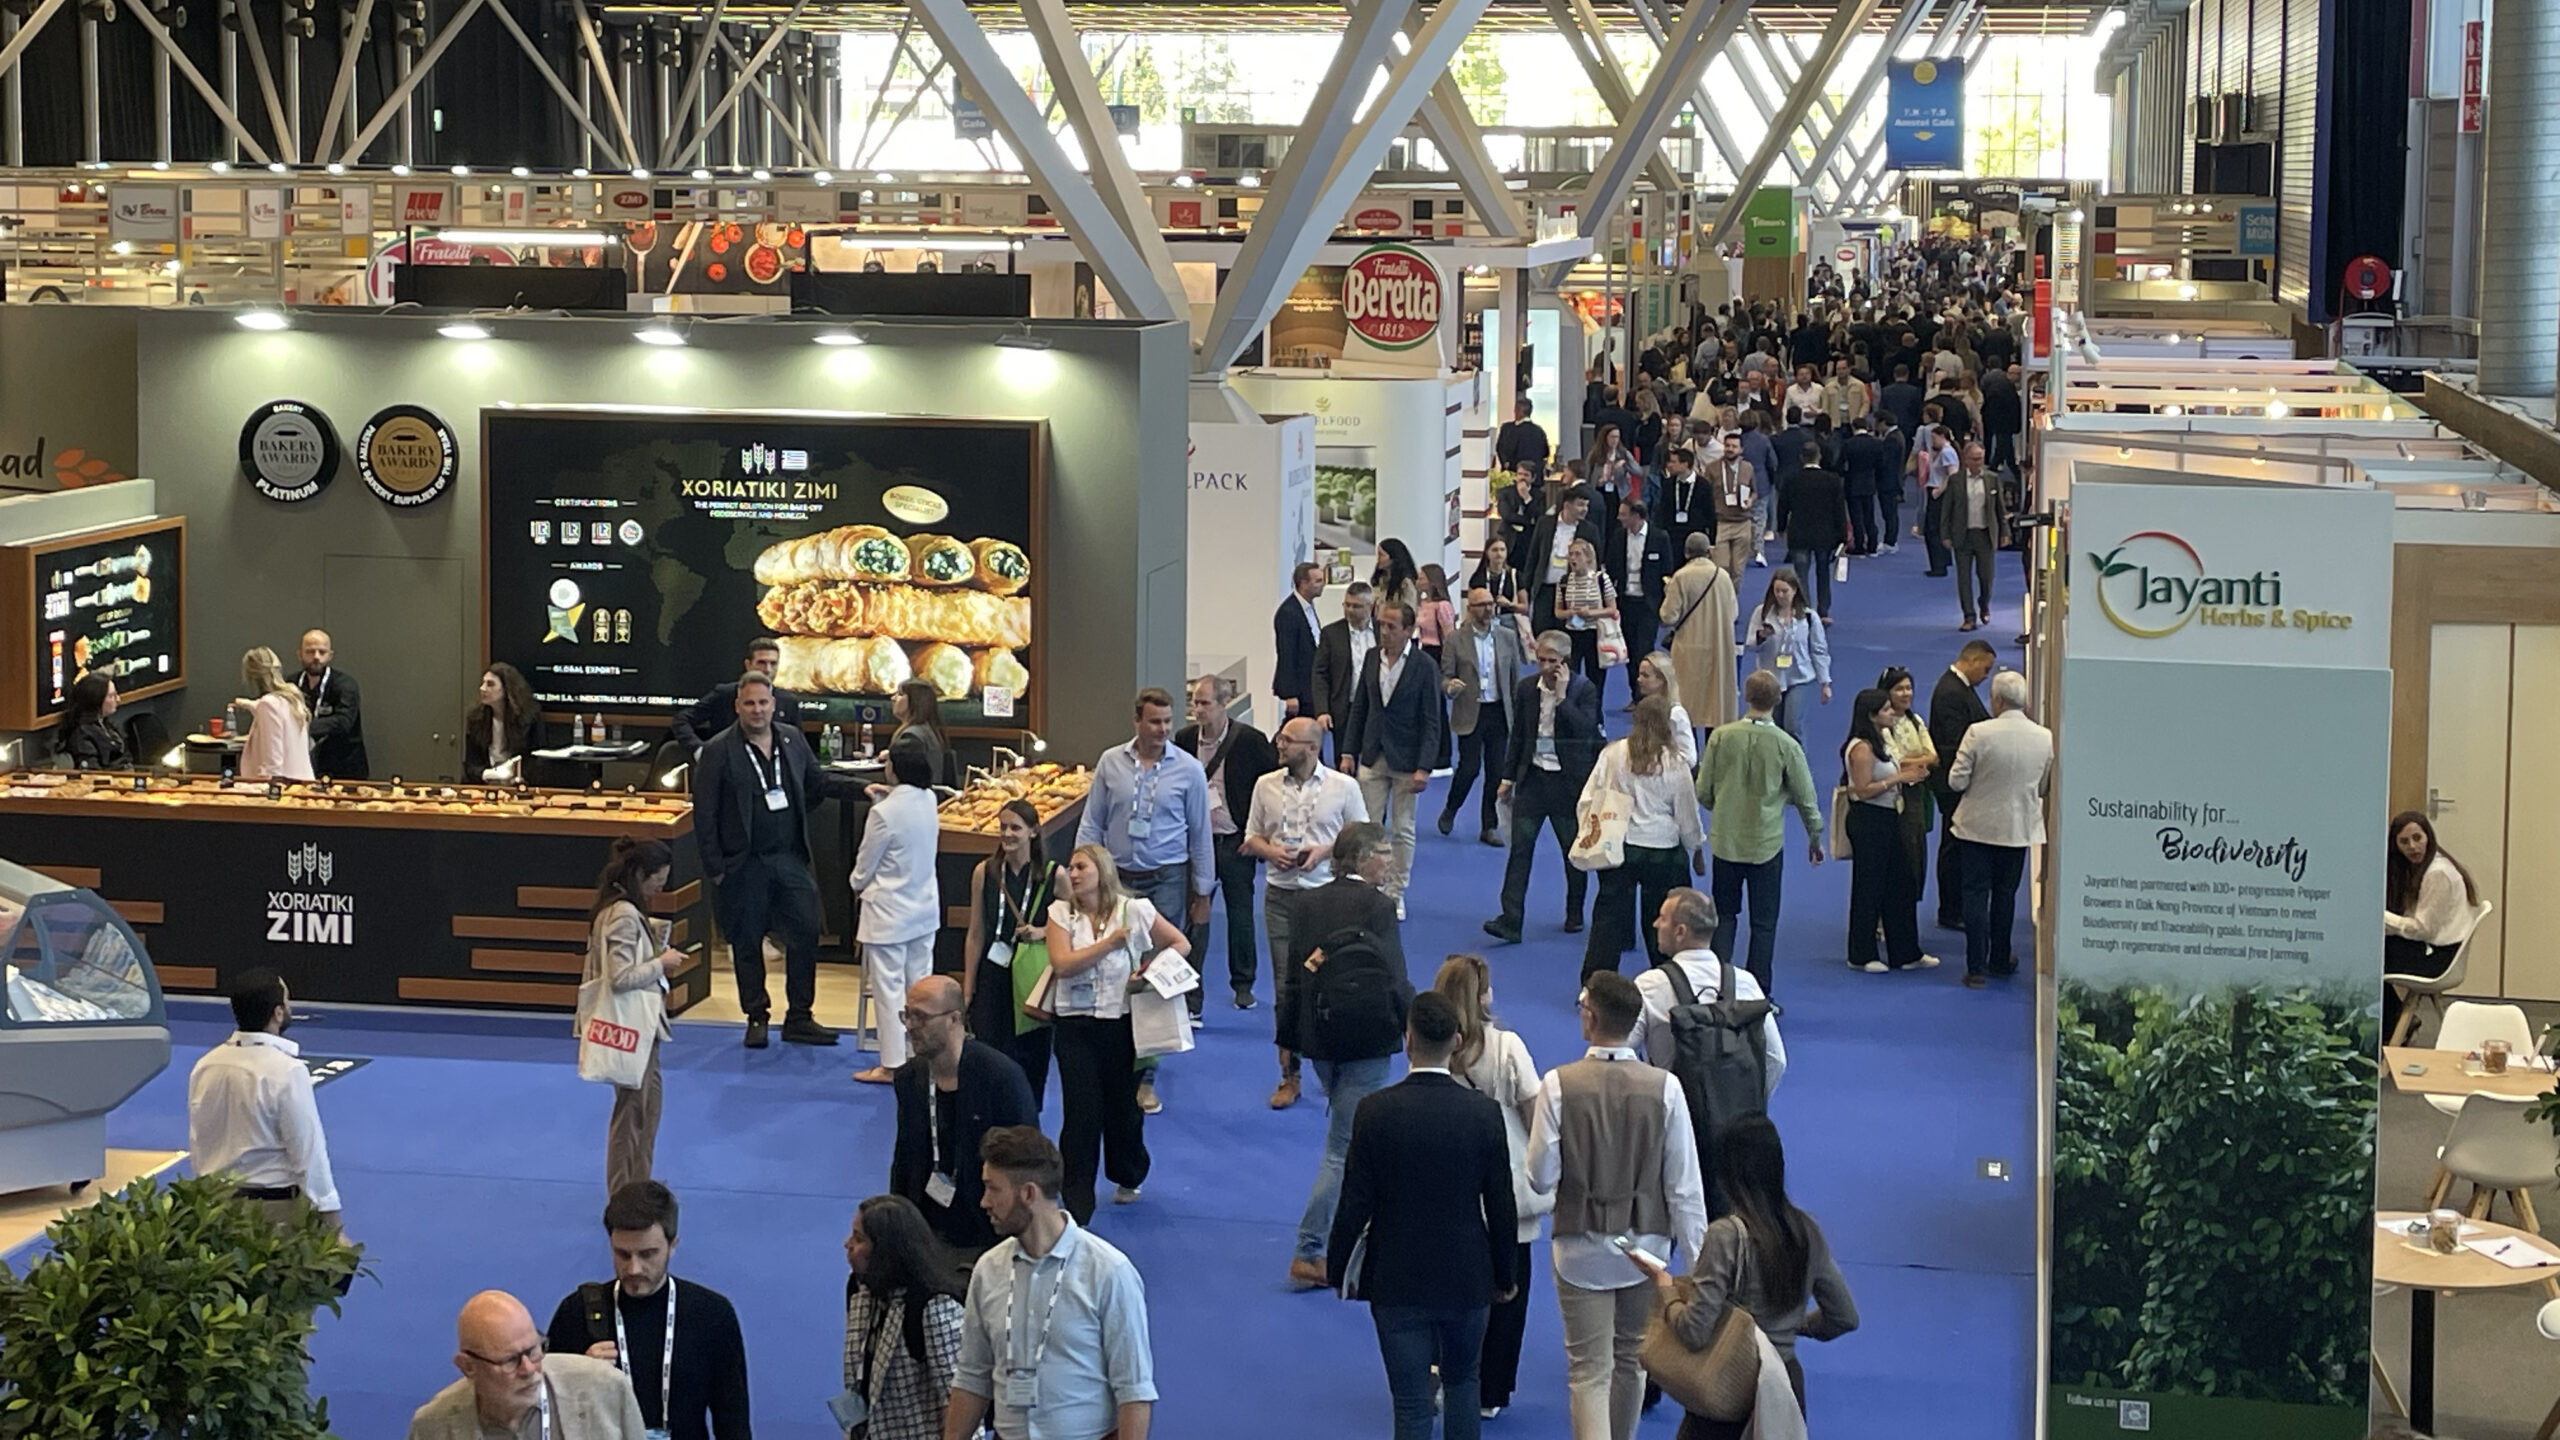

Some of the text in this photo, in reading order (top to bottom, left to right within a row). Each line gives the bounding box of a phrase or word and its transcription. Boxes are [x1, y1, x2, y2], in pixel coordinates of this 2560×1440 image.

[415, 242, 474, 261] Fratelli
[1372, 257, 1411, 276] Fratelli
[1347, 268, 1439, 322] Beretta
[1377, 321, 1405, 338] 1812
[259, 440, 319, 452] BAKERY
[260, 452, 319, 465] AWARDS
[377, 445, 435, 458] BAKERY
[378, 456, 437, 470] AWARDS
[255, 476, 320, 501] PLATINUM
[681, 480, 838, 500] XORIATIKI ZIMI
[1188, 472, 1249, 492] PACK
[2135, 565, 2282, 615] Jayanti
[2200, 607, 2353, 633] Herbs & Spice
[2088, 797, 2199, 827] Sustainability
[2155, 826, 2309, 883] Biodiversity
[2083, 874, 2119, 890] Jayanti
[2120, 876, 2138, 890] has
[2140, 879, 2188, 892] partnered
[2189, 880, 2210, 893] with
[2238, 885, 2296, 899] progressive
[2297, 885, 2331, 902] Pepper
[267, 891, 354, 913] XORIATIKI
[2083, 895, 2122, 909] Growers
[2124, 899, 2134, 909] in
[2181, 900, 2224, 915] Province
[2226, 903, 2236, 919] of
[2238, 904, 2279, 918] Vietnam
[2280, 906, 2290, 919] to
[2291, 908, 2317, 920] meet
[266, 910, 353, 945] ZIMI
[2082, 915, 2139, 933] Biodiversity
[2141, 920, 2159, 932] and
[2160, 920, 2215, 938] Traceability
[2247, 924, 2293, 943] Enriching
[2294, 927, 2325, 942] farms
[2082, 936, 2119, 953] through
[2121, 940, 2181, 955] regenerative
[2183, 944, 2201, 955] and
[2202, 942, 2247, 958] chemical
[2248, 946, 2268, 961] free
[588, 1020, 637, 1050] FOOD
